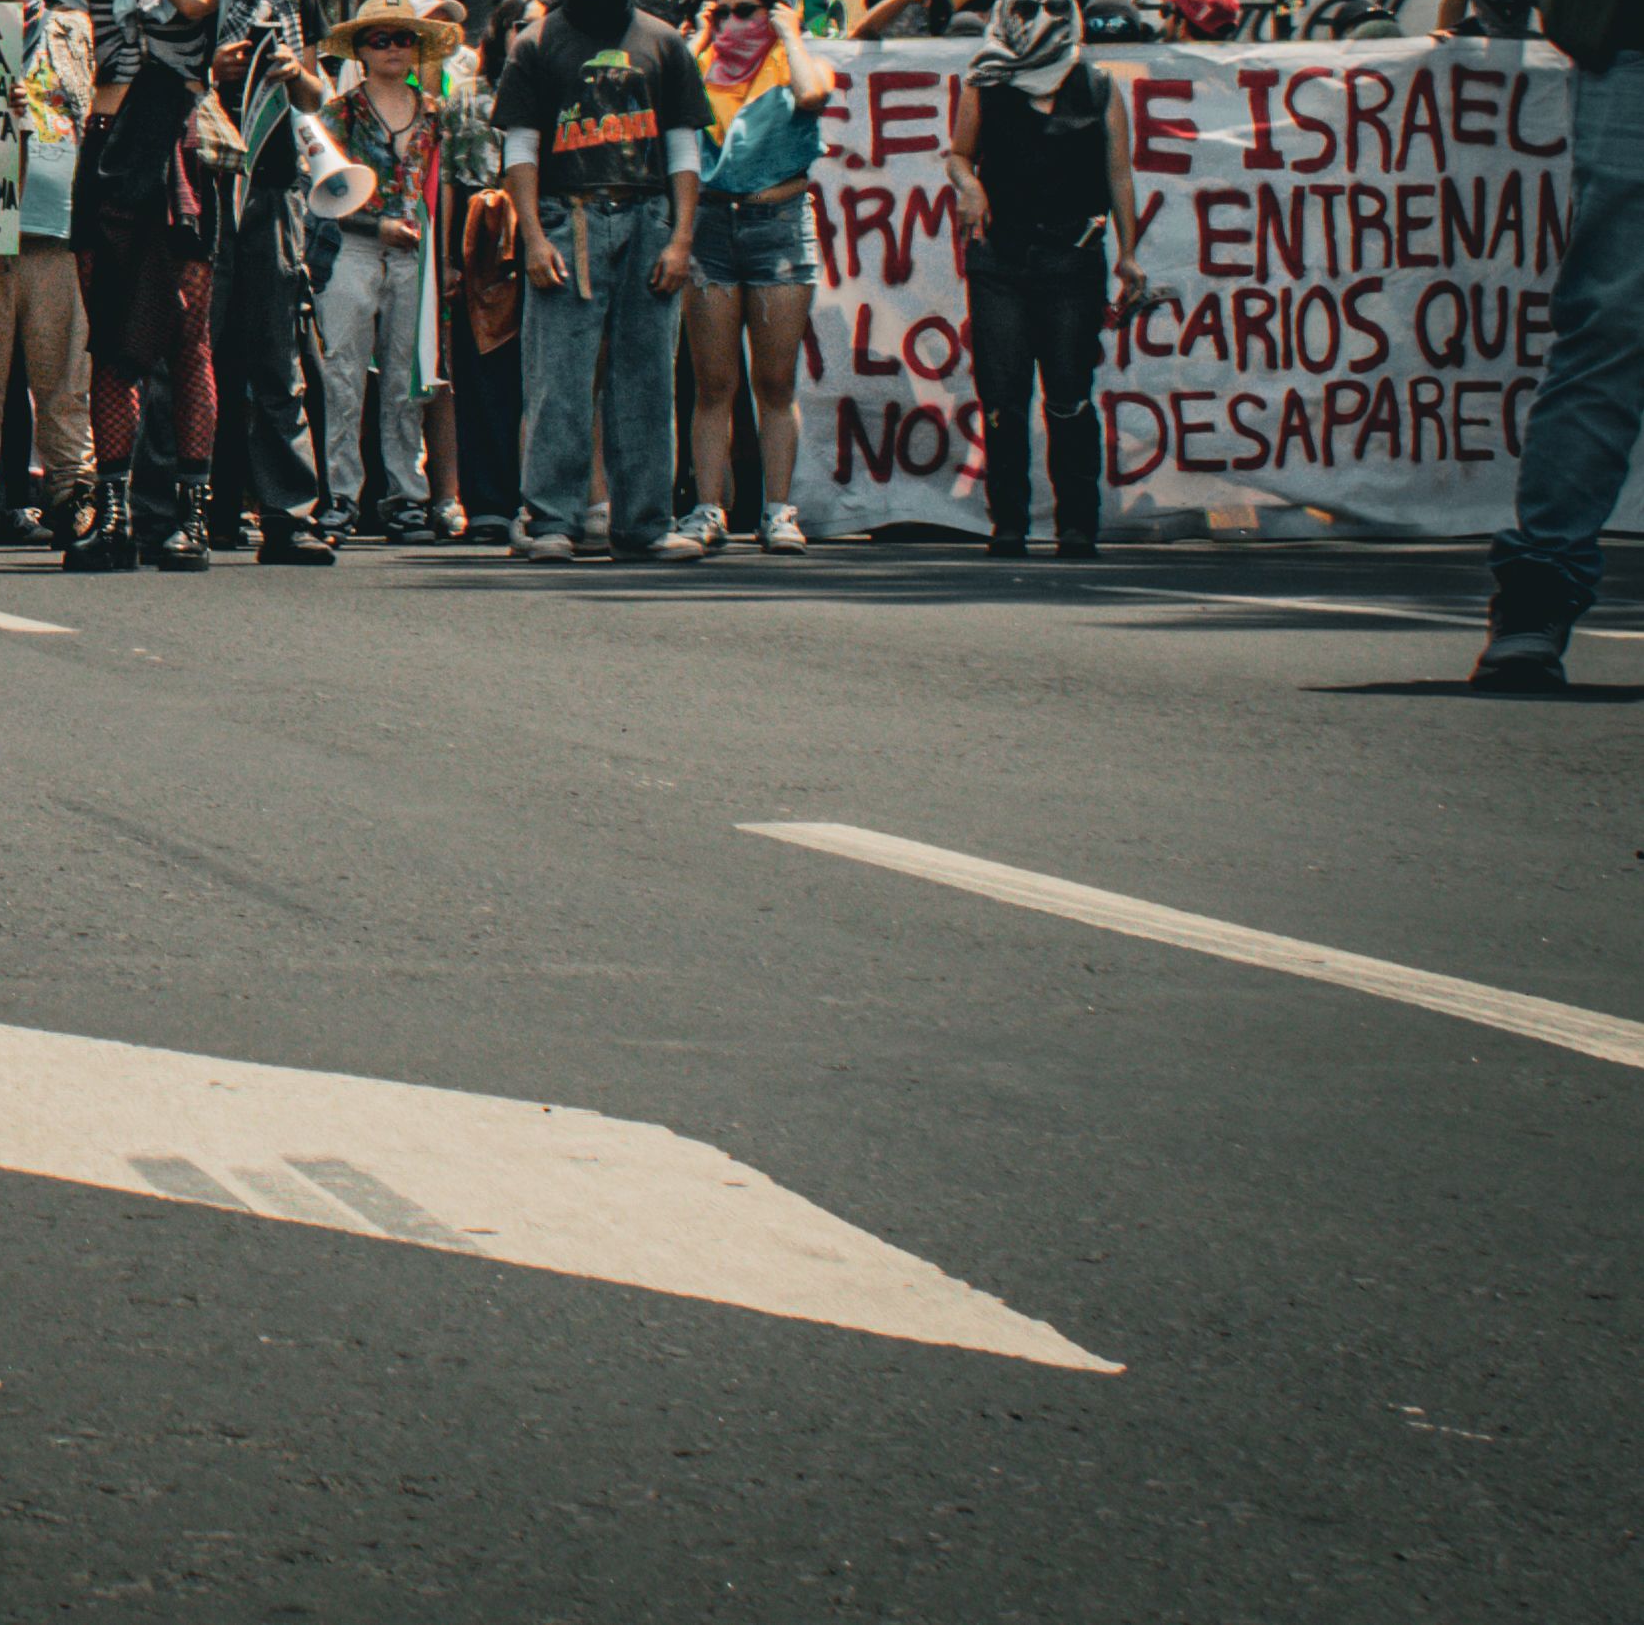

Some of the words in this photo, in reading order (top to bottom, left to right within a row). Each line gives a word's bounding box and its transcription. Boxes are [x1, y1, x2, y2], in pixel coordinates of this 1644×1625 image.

[1133, 77, 1199, 174] E
[1237, 64, 1567, 174] ISRAEL
[1194, 169, 1572, 284] ENTRENAN
[1099, 276, 1390, 375] ICARIOS
[1414, 278, 1553, 370] QUE
[1100, 375, 1540, 488] DESAPAREC
